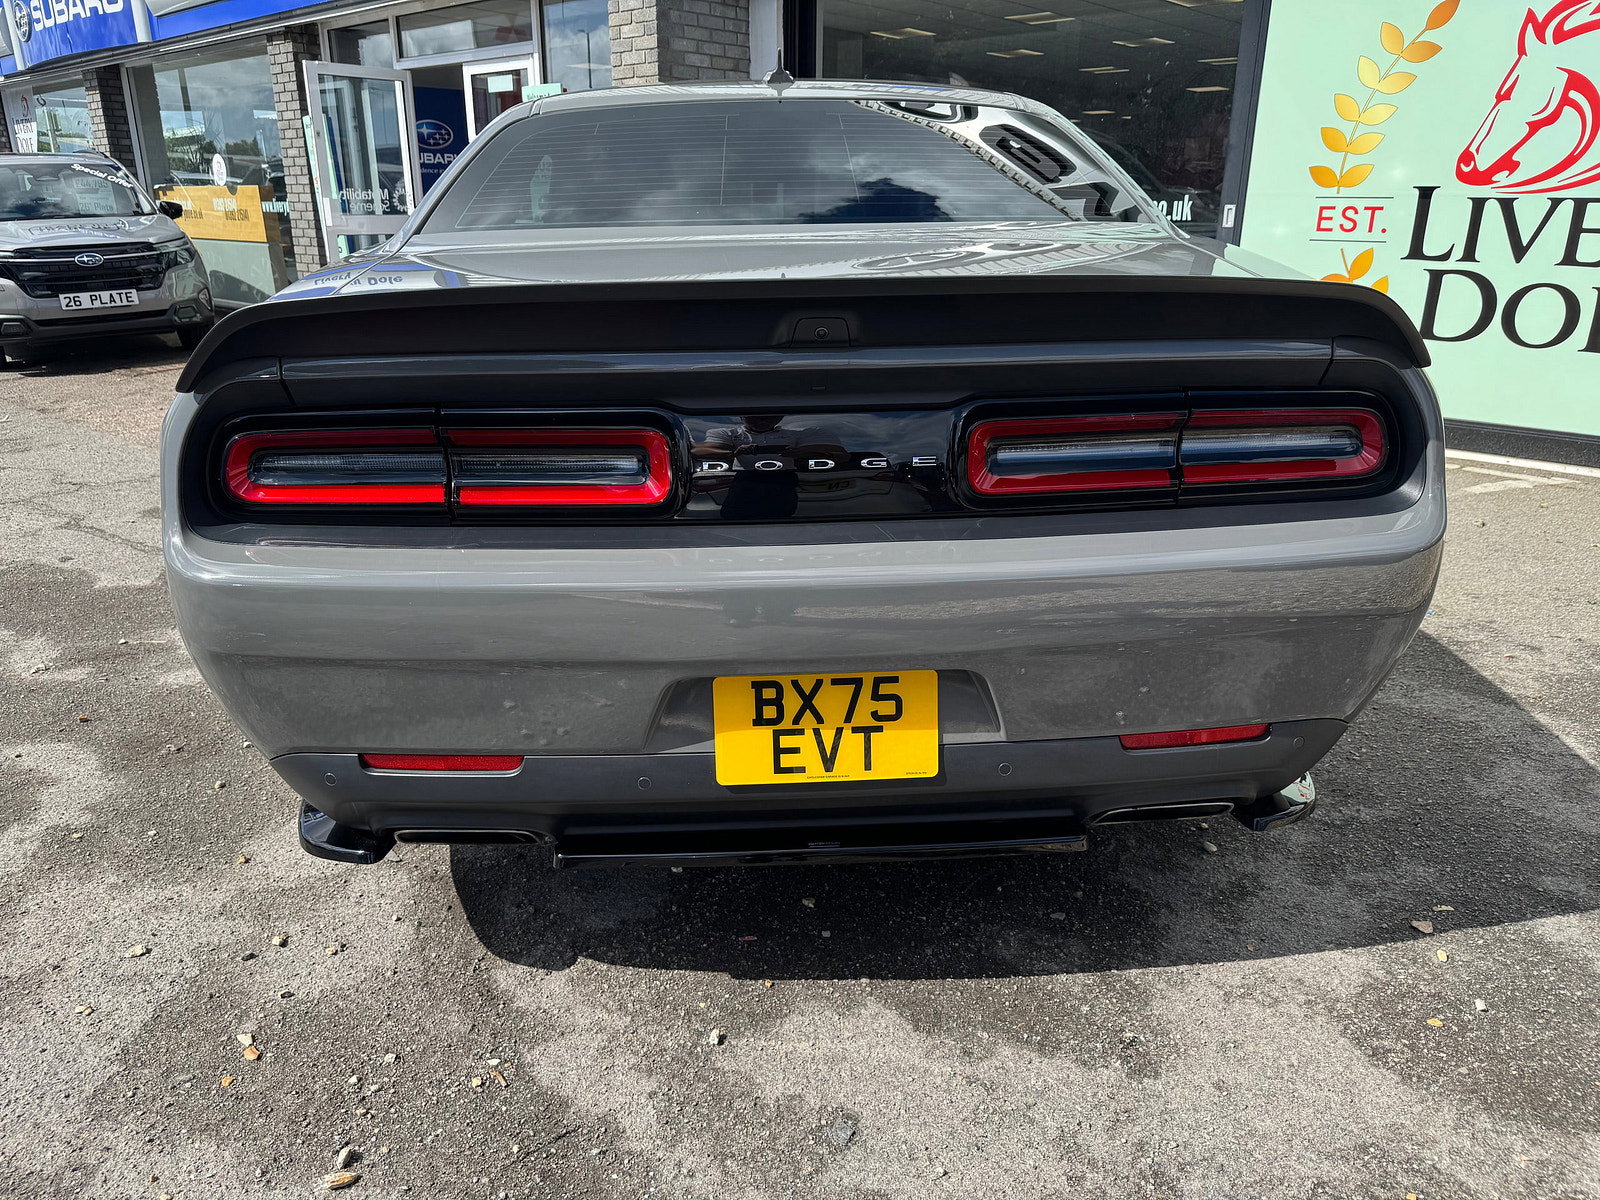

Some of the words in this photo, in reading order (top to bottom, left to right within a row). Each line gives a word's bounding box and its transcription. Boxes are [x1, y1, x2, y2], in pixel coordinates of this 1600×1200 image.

[71, 163, 107, 179] Special
[107, 175, 134, 188] Offer
[1315, 205, 1387, 235] EST.
[63, 295, 83, 308] 26
[89, 291, 135, 306] PLATE
[702, 456, 937, 472] DODGE
[751, 675, 904, 727] BX75
[772, 725, 885, 775] EVT
